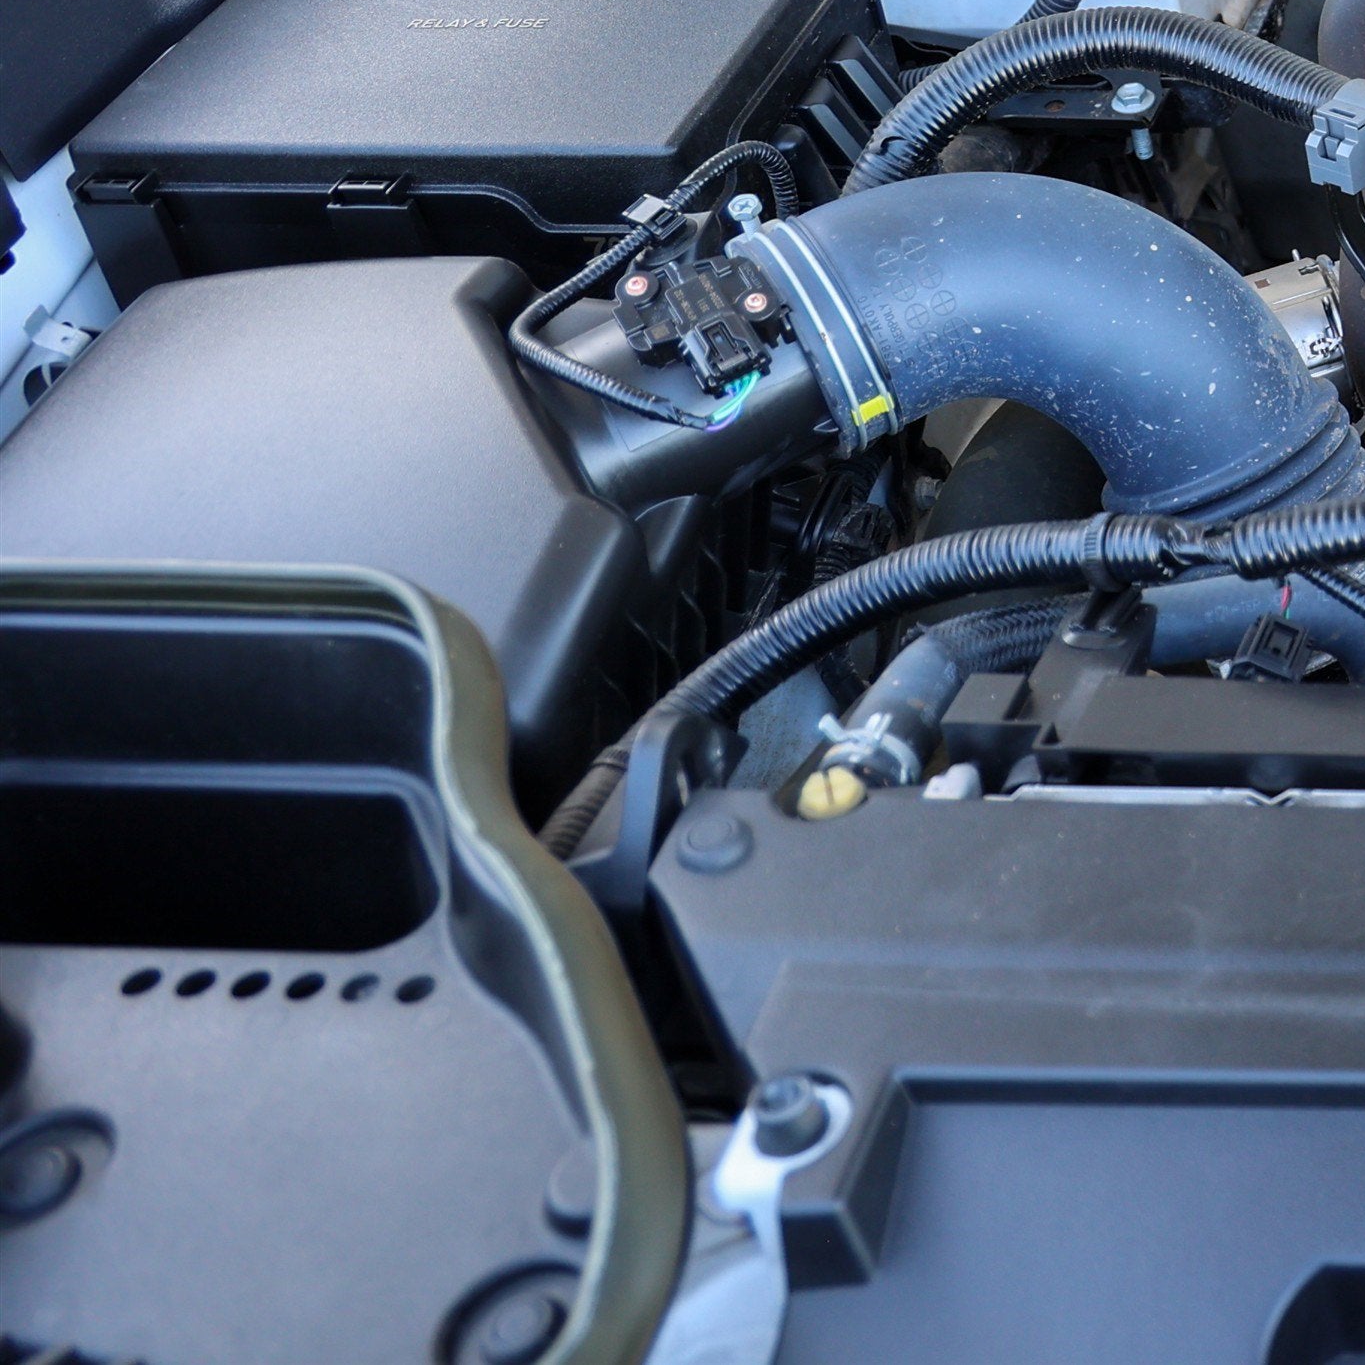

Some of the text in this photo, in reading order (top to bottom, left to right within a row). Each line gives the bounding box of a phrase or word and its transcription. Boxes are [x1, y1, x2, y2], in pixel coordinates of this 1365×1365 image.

[407, 18, 549, 29] RELAY & FUSE
